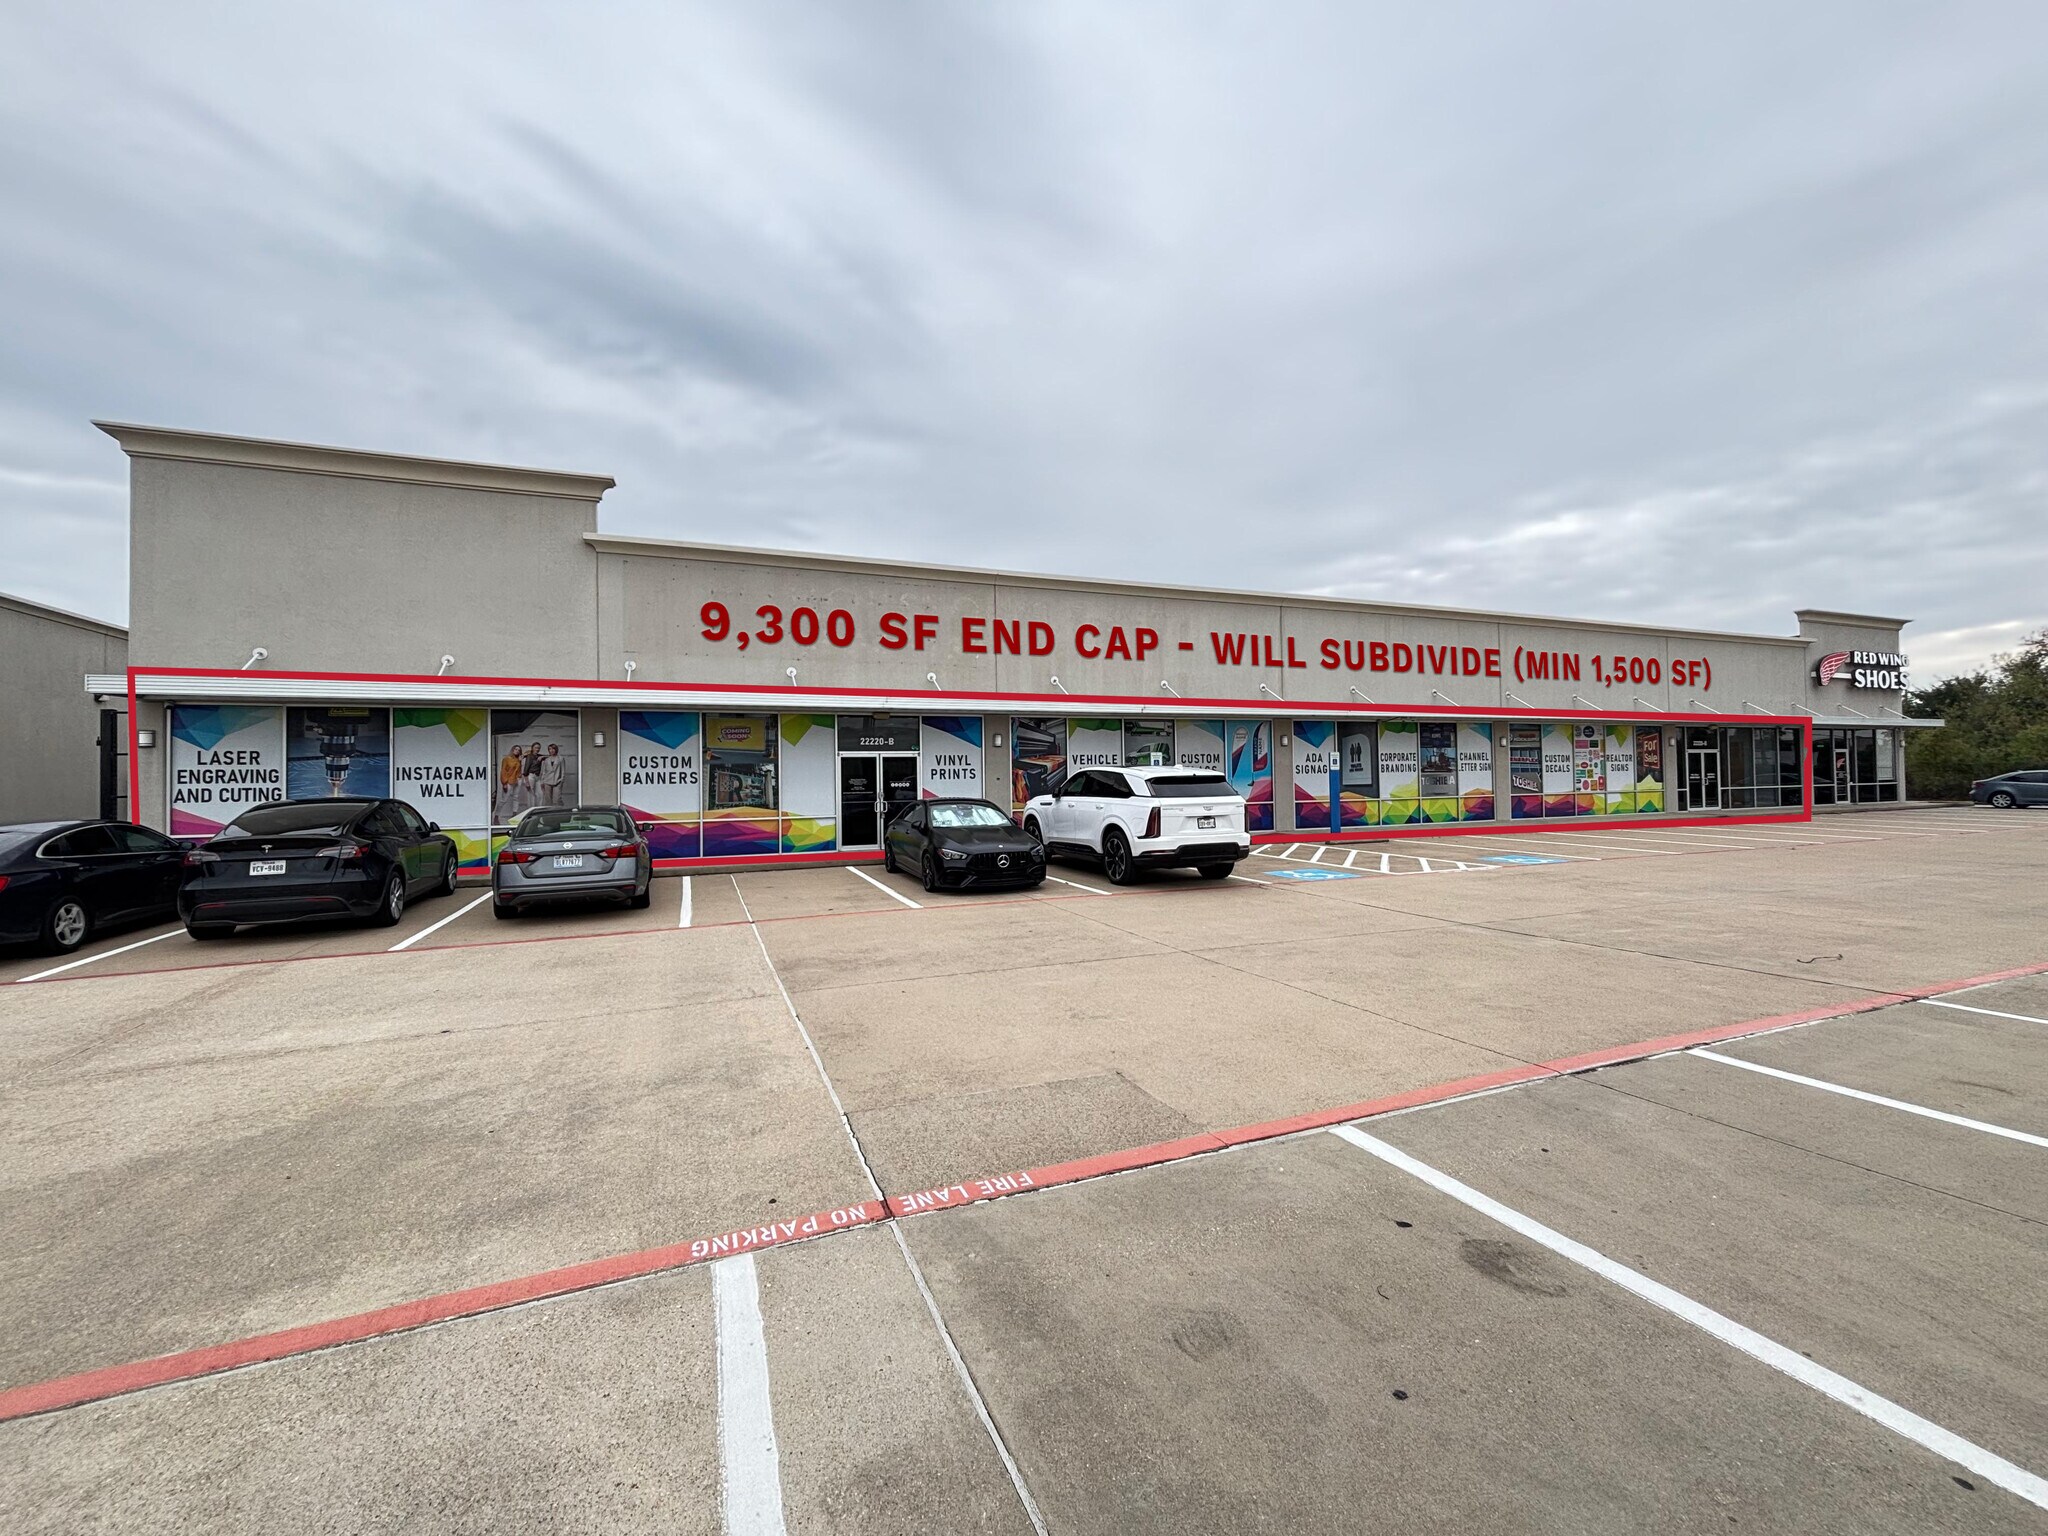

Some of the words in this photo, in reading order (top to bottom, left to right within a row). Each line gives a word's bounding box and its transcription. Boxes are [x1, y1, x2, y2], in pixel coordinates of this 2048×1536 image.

[1853, 650, 1879, 665] RED
[1878, 652, 1911, 668] WING
[1854, 668, 1911, 691] SHOES
[721, 726, 751, 735] COMING
[859, 737, 896, 747] 22220-B
[197, 750, 261, 766] LASER
[628, 755, 693, 769] CUSTOM
[935, 754, 973, 766] VINYL
[1071, 754, 1118, 765] VEHICLE
[1180, 753, 1220, 764] CUSTOM
[1305, 752, 1324, 763] ADA
[1380, 752, 1417, 762] CORPORATE
[1459, 752, 1490, 761] CHANNEL
[1544, 754, 1571, 763] CUSTOM
[1606, 754, 1633, 762] REALTOR
[1644, 753, 1658, 764] Sale
[395, 766, 487, 781] INSTAGRAM
[1295, 765, 1329, 775] SIGNAG
[1380, 763, 1417, 773] BRANDING
[1545, 764, 1571, 773] DECALS
[1610, 763, 1630, 772] SIGNS
[176, 769, 280, 785] ENGRAVING
[622, 771, 699, 786] BANNERS
[930, 768, 977, 781] PRINTS
[173, 787, 212, 804] AND
[218, 787, 283, 803] CUTING
[419, 783, 465, 798] WALL
[974, 1171, 1034, 1196] FIRE
[902, 1185, 970, 1212] LANE
[831, 1205, 866, 1224] NO
[691, 1219, 818, 1258] PARKING
